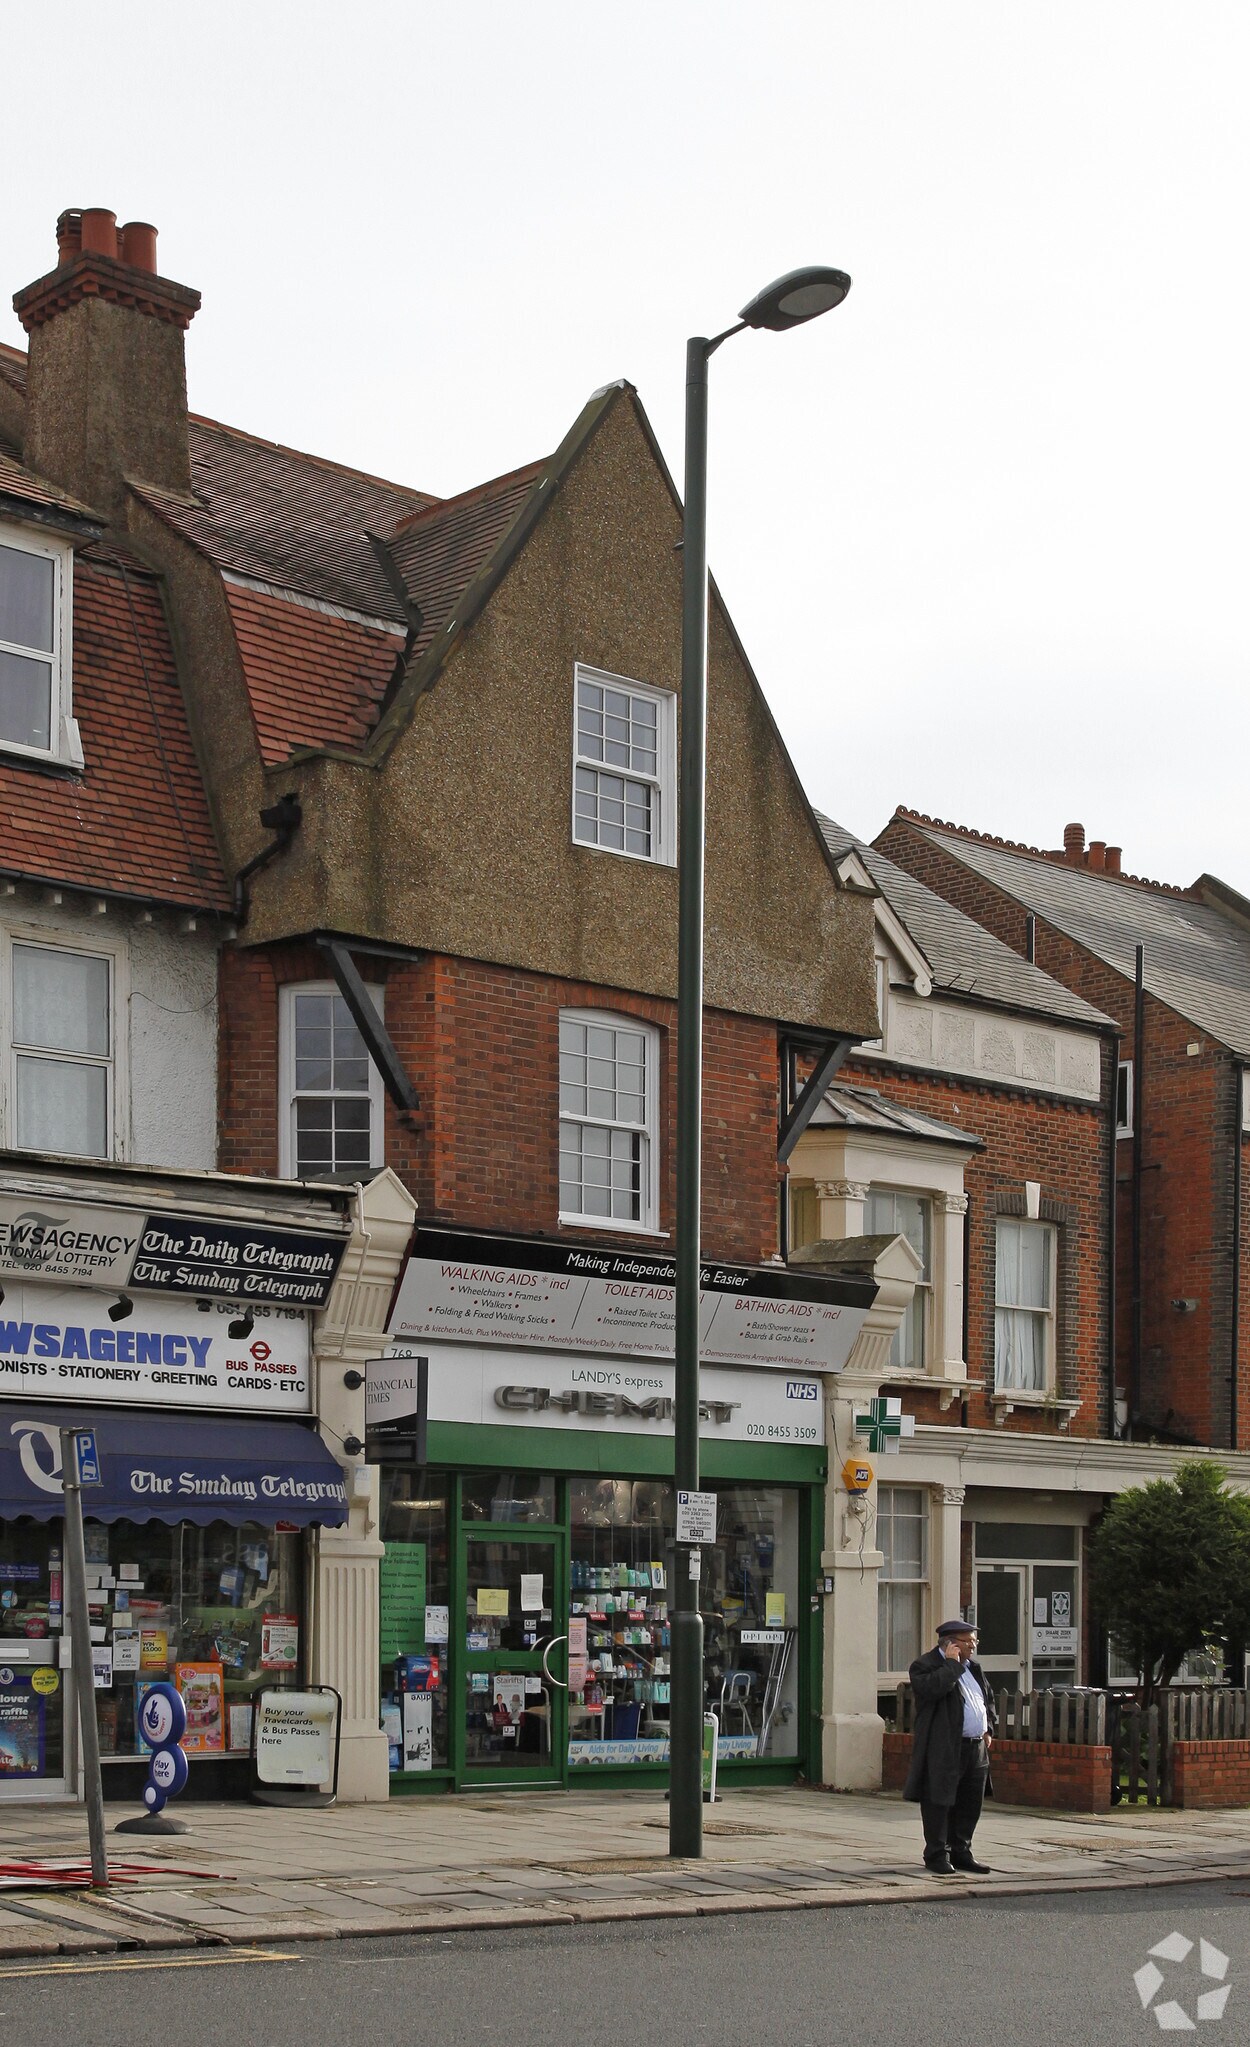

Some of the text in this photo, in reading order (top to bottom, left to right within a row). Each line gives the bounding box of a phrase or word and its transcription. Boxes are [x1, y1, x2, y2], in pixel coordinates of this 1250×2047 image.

[0, 1244, 117, 1267] TIONAL LOTTERY
[142, 1230, 334, 1273] The Daily Telegraph
[1, 1259, 93, 1276] TEL: 020 8455 7194
[566, 1253, 610, 1273] Making
[713, 1270, 748, 1287] Easier
[133, 1262, 324, 1300] The Sunday Telegraph
[440, 1265, 571, 1290] WALKING AIDS incl
[458, 1285, 542, 1302] Wheelchairs Frames
[604, 1283, 674, 1300] TOILET AIDS
[481, 1299, 512, 1310] Walkers
[735, 1299, 841, 1320] BATHING AIDS incl
[275, 1307, 306, 1320] 7194
[434, 1306, 463, 1319] Folding
[473, 1310, 494, 1320] Fixed
[495, 1312, 525, 1325] Walking
[527, 1315, 549, 1324] Sticks
[613, 1307, 637, 1317] Raised
[639, 1310, 658, 1319] Toilet
[602, 1317, 648, 1329] Incontinence
[751, 1321, 809, 1334] Bath/Shower seats
[744, 1331, 767, 1341] Boards
[775, 1334, 792, 1342] Grab
[400, 1322, 423, 1332] Dining
[432, 1325, 457, 1334] kitchen
[476, 1328, 489, 1336] Plus
[490, 1329, 528, 1340] Wheelchair
[619, 1341, 633, 1349] Free
[633, 1342, 653, 1351] Home
[704, 1349, 751, 1360] Demonstrations
[751, 1354, 778, 1363] Arranged
[778, 1355, 803, 1365] Weekday
[804, 1358, 828, 1368] Evenings
[226, 1360, 297, 1374] BUS PASSES
[58, 1365, 141, 1381] STATIONERY
[151, 1371, 217, 1386] GREETING
[228, 1376, 271, 1390] CARDS
[280, 1380, 305, 1392] ETC
[571, 1369, 663, 1390] LANDY'S express
[367, 1379, 416, 1393] FINANCIAL
[787, 1383, 817, 1399] NHS
[367, 1393, 390, 1404] TIMES
[747, 1424, 817, 1439] 020 8455 3509
[80, 1437, 91, 1457] P
[130, 1470, 173, 1494] The
[177, 1471, 258, 1500] Sunday
[681, 1494, 688, 1503] P
[1, 1708, 29, 1716] raffle
[265, 1708, 281, 1716] Buy
[264, 1717, 313, 1725] Travelcards
[262, 1726, 269, 1734] &
[291, 1728, 320, 1736] Passes
[261, 1737, 282, 1745] here
[731, 1740, 752, 1749] Living
[588, 1745, 605, 1754] Aids
[607, 1745, 616, 1753] for
[618, 1744, 636, 1754] Daily
[638, 1743, 659, 1753] Living
[155, 1760, 170, 1770] Play
